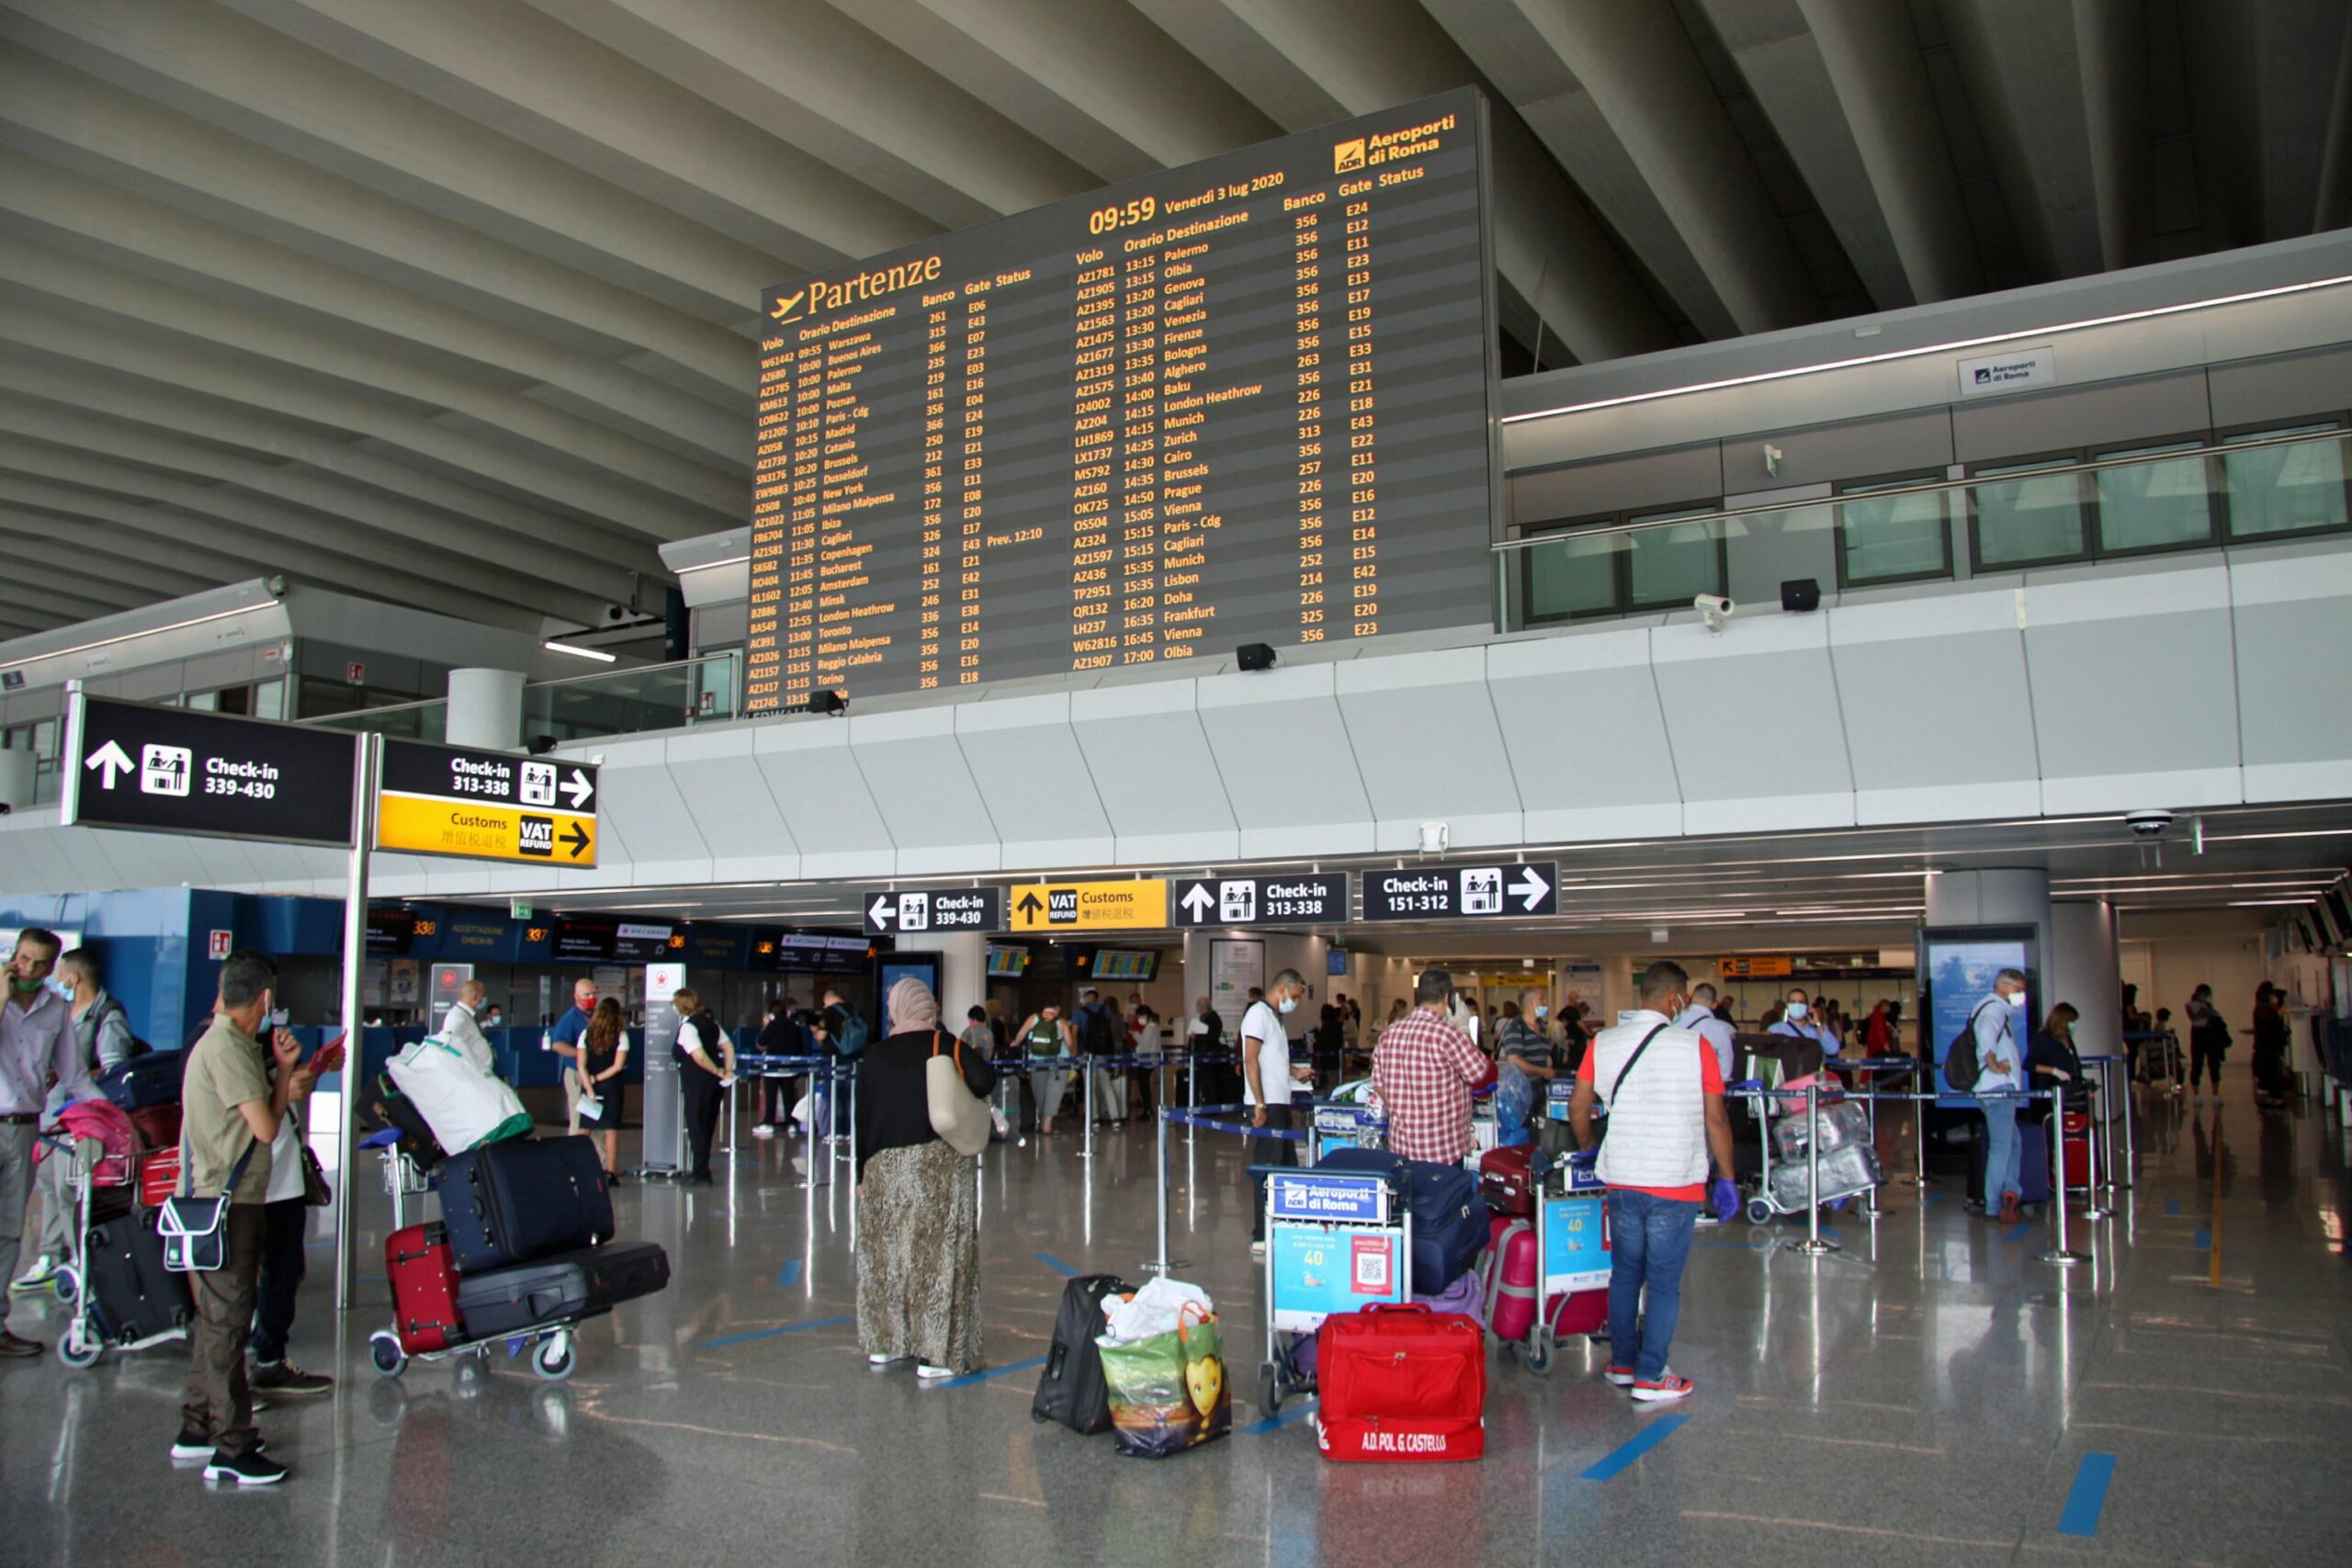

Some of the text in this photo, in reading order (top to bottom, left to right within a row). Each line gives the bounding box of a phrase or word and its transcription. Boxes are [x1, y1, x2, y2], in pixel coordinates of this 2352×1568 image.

[1368, 114, 1455, 151] Aeroporti
[1368, 138, 1440, 165] di Roma
[1337, 158, 1363, 172] ADR
[1164, 171, 1284, 214] Venerdì 3 lug 2020
[1075, 166, 1425, 265] Volo Orario Destinazione Banco Gate Status
[1089, 196, 1156, 235] 09:59
[1077, 200, 1369, 284] AZ1781 13:15 Palermo 356 E24
[808, 254, 942, 315] Partenze
[1076, 235, 1370, 317] AZ1395 13:20 Genova 356 E11
[761, 269, 1032, 351] Volo Orario Destinazione Banco Gate Status
[1075, 270, 1371, 349] AZ1475 13:30 Venezia 356 E13
[797, 344, 822, 359] 09:55
[828, 332, 872, 351] Warszawa
[929, 310, 946, 324] 261
[967, 299, 987, 314] E06
[1075, 306, 1372, 381] AZ1319 13:35 Bologna 356 E19
[1993, 360, 2036, 373] Aeroporti
[1993, 371, 2030, 382] di Roma
[1075, 360, 1373, 431] AZ204 14:15 London Heathrow 356 E31
[1074, 396, 1374, 465] LX1737 14:25 Zurich 226 E18
[1073, 433, 1374, 497] AZ160 14:35 Brussels 356 E22
[793, 491, 817, 506] 10:40
[822, 488, 843, 500] New
[843, 481, 865, 495] York
[924, 465, 943, 479] 361
[964, 457, 983, 471] E33
[1073, 469, 1375, 533] OS504 15:05 Vienna 226 E20
[1073, 507, 1375, 566] AZ1597 15:15 Cagliari 356 E12
[789, 568, 814, 582] 11:45
[820, 560, 863, 577] Bucharest
[922, 545, 941, 559] 324
[962, 537, 981, 551] E43
[986, 535, 1012, 547] Prev.
[1014, 527, 1044, 544] 12:10
[1074, 545, 1377, 600] TP2951 15:35 Lisbon 252 E15
[788, 614, 813, 628] 12:55
[819, 610, 851, 624] London
[851, 603, 896, 618] Heathrow
[922, 593, 940, 607] 246
[961, 587, 979, 601] E31
[1072, 582, 1378, 636] LH237 16:35 Frankfurt 226 E19
[1072, 621, 1379, 670] AZ1907 17:00 Olbia 356 E23
[786, 676, 811, 691] 13:15
[817, 673, 845, 686] Torino
[921, 660, 939, 672] 356
[959, 654, 979, 668] E16
[206, 757, 279, 781] Check-in
[450, 757, 511, 779] Check-in
[205, 777, 276, 800] 339-430
[452, 776, 511, 796] 313-338
[450, 812, 508, 830] Customs
[520, 821, 552, 840] VAT
[519, 838, 552, 851] REFUND
[1267, 883, 1328, 899] Check-in
[1383, 876, 1449, 894] Check-in
[935, 896, 985, 910] Check-in
[1049, 894, 1077, 909] VAT
[1081, 891, 1135, 905] Customs
[1267, 901, 1323, 915] 313-338
[1387, 896, 1449, 912] 151-312
[935, 911, 982, 924] 339-430
[1049, 910, 1077, 919] REFUND
[413, 920, 436, 935] 338
[526, 928, 549, 942] 337
[1308, 1185, 1370, 1201] Aeroporti
[1308, 1198, 1359, 1212] di Roma
[1567, 1218, 1583, 1232] 40
[1304, 1249, 1324, 1266] 40
[1406, 1433, 1447, 1452] CASTELLO
